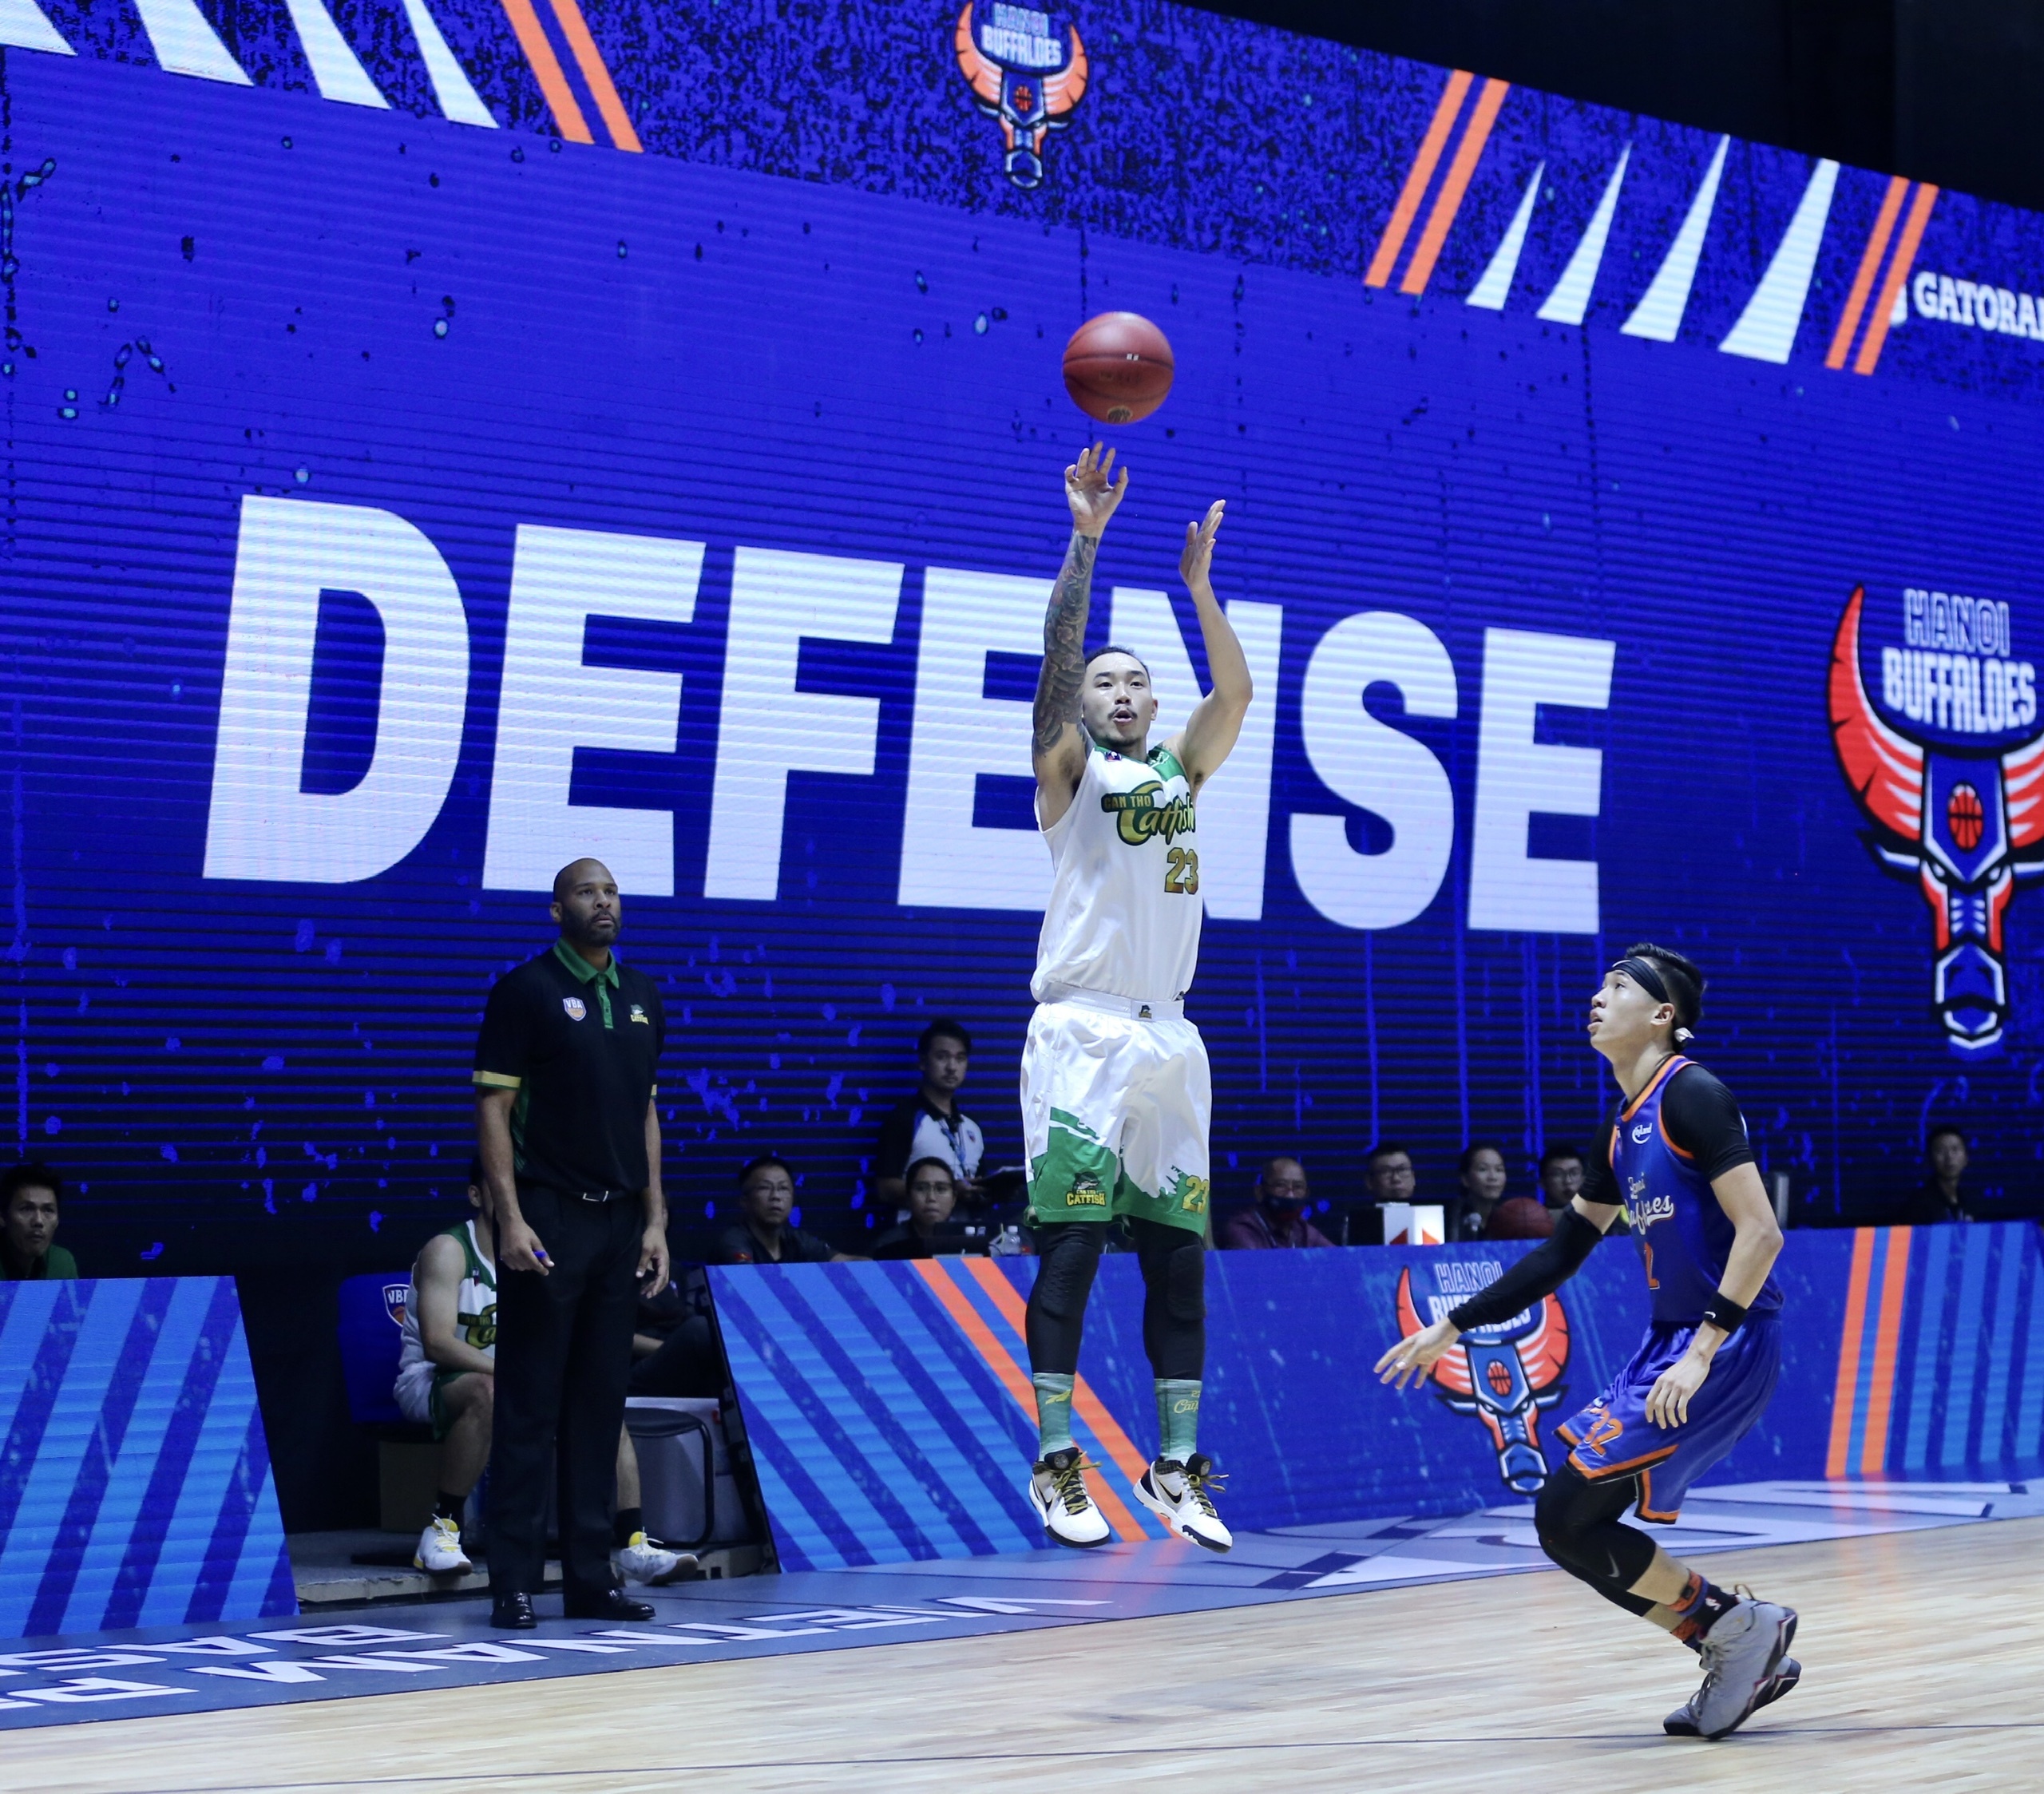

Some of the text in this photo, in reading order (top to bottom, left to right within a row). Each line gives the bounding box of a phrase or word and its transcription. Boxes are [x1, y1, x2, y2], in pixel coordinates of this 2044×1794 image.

[1913, 271, 2044, 342] GATORA
[1903, 588, 2010, 657] HANOI
[1881, 646, 2037, 733] BUFFALOES
[1164, 847, 1198, 894] 23
[565, 999, 583, 1009] VBA
[1066, 1193, 1106, 1206] CATFISH
[1182, 1175, 1210, 1214] 23
[184, 1596, 1114, 1684] VIETNAM
